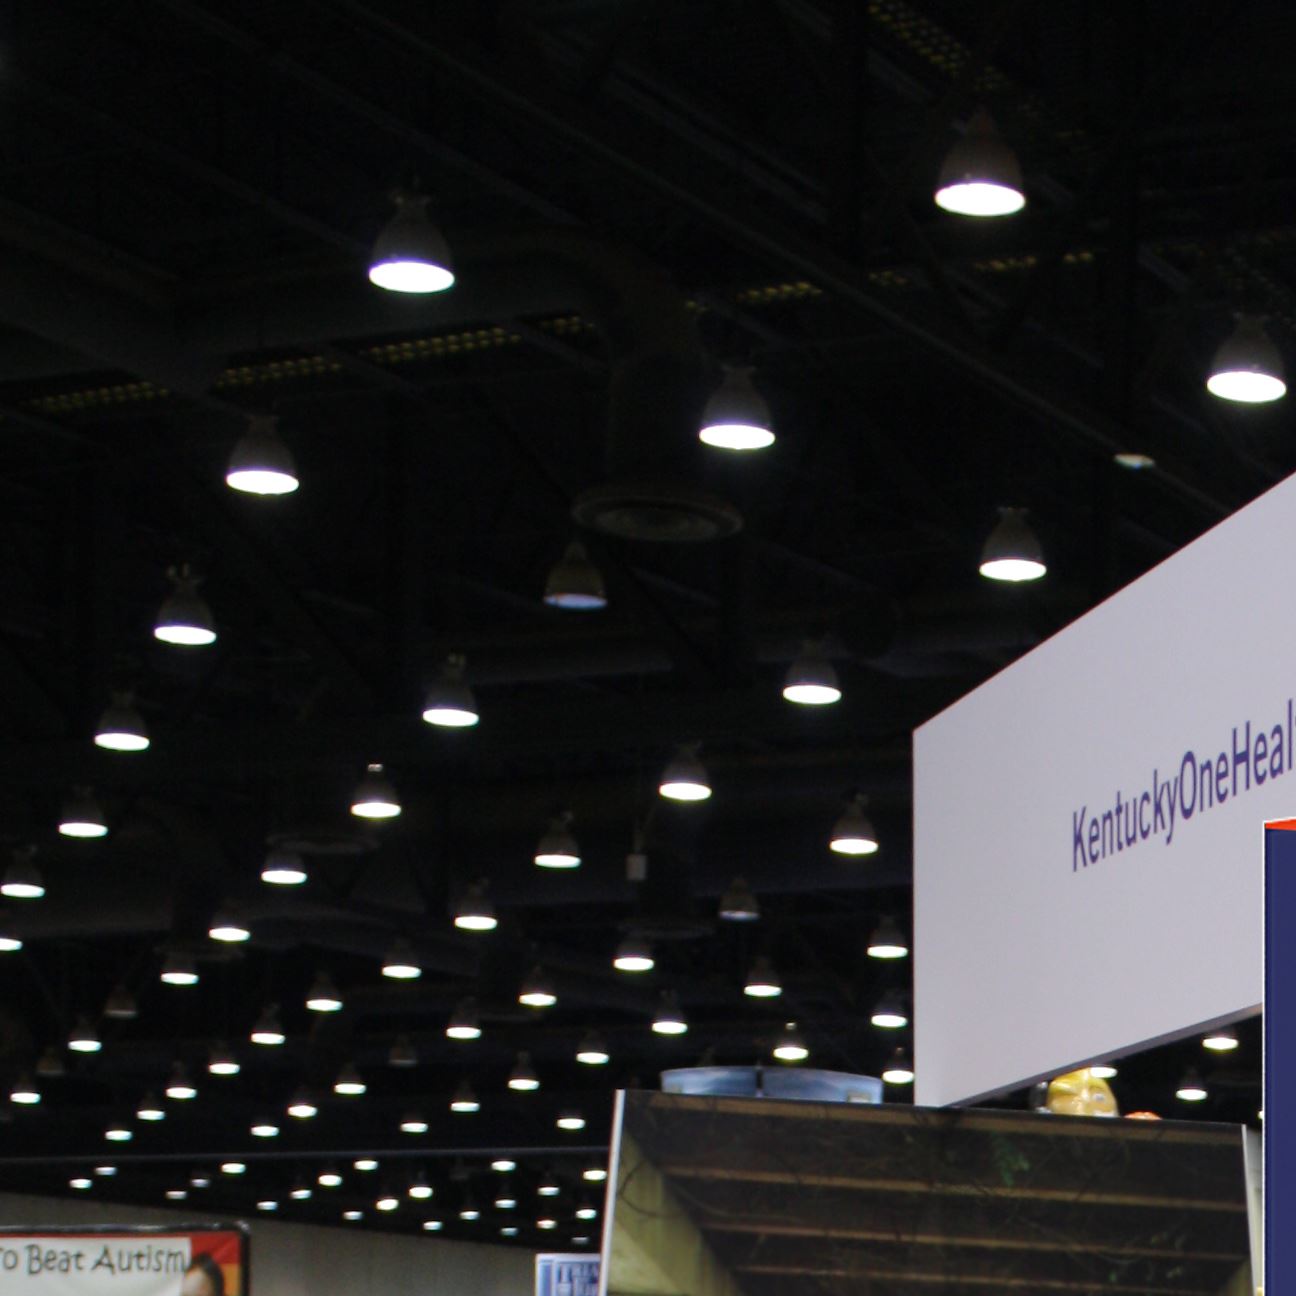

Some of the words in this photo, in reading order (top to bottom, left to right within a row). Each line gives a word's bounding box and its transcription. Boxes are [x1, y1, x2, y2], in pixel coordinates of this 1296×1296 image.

[0, 1243, 18, 1271] o
[26, 1244, 85, 1275] Beat
[91, 1245, 187, 1276] Autism
